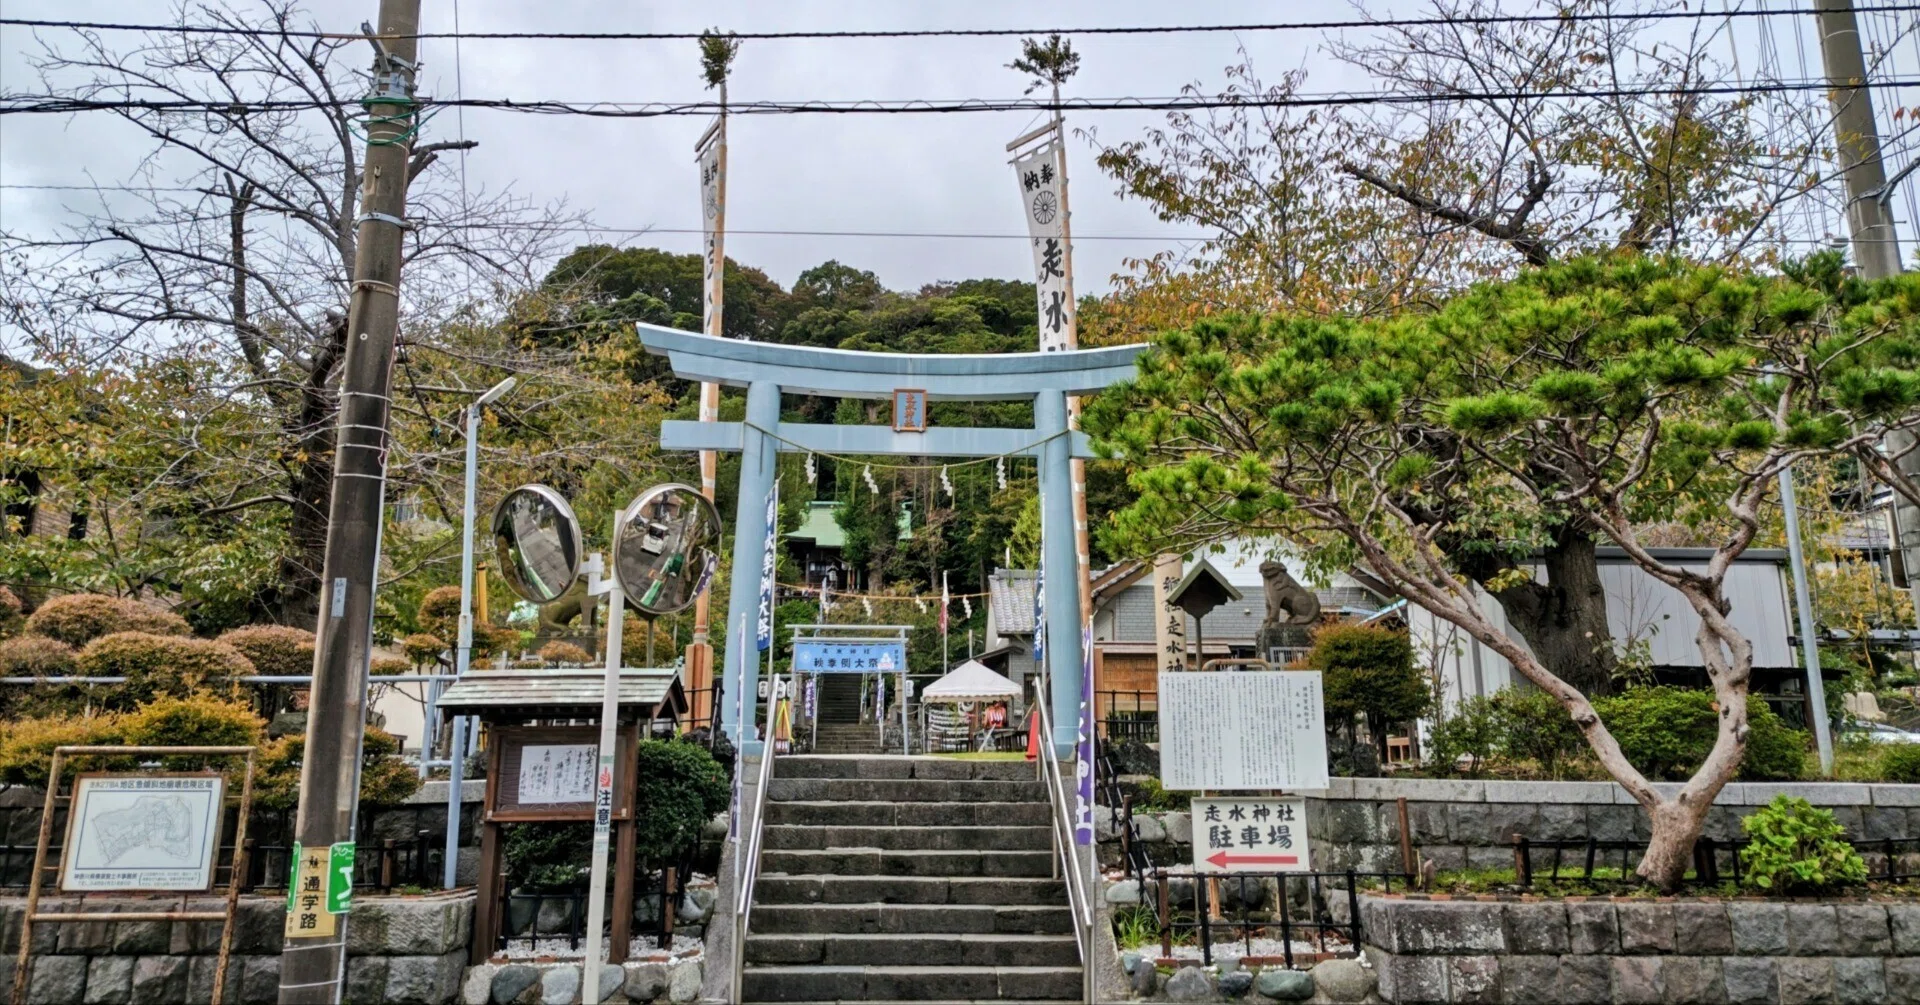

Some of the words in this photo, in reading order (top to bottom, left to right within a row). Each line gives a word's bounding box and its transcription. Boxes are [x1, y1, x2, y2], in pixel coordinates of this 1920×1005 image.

[1042, 238, 1069, 352] 走水
[597, 790, 611, 826] 注意
[1204, 804, 1296, 823] 走水神社
[1209, 825, 1293, 849] 駐車場
[299, 876, 321, 929] 通学路
